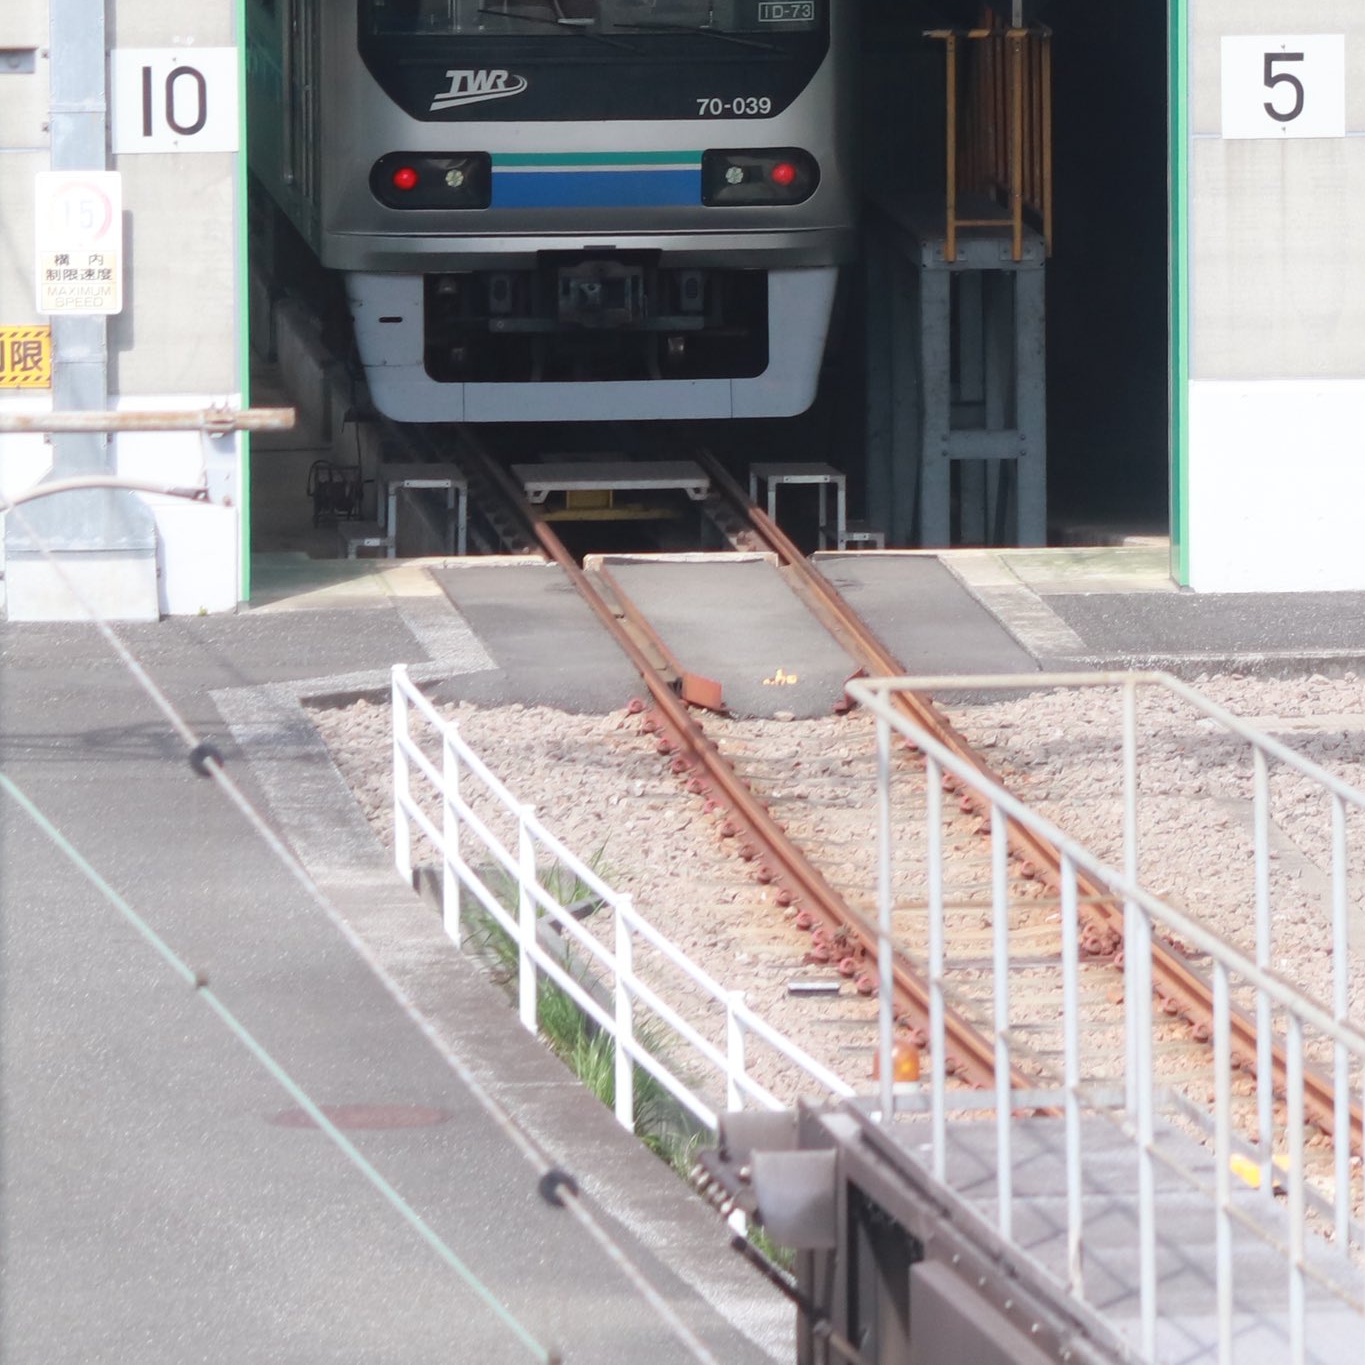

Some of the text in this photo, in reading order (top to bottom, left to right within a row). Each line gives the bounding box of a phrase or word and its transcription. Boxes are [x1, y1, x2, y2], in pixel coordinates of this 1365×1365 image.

[764, 4, 812, 19] ID-73
[436, 69, 524, 98] TWR
[1263, 52, 1305, 122] 5
[141, 65, 208, 137] 10
[697, 97, 772, 115] 70-039
[64, 198, 94, 229] 15
[46, 268, 113, 281] 制限速度
[47, 286, 112, 296] MAXIMUM
[55, 296, 104, 307] SPEED
[0, 340, 43, 373] 限
